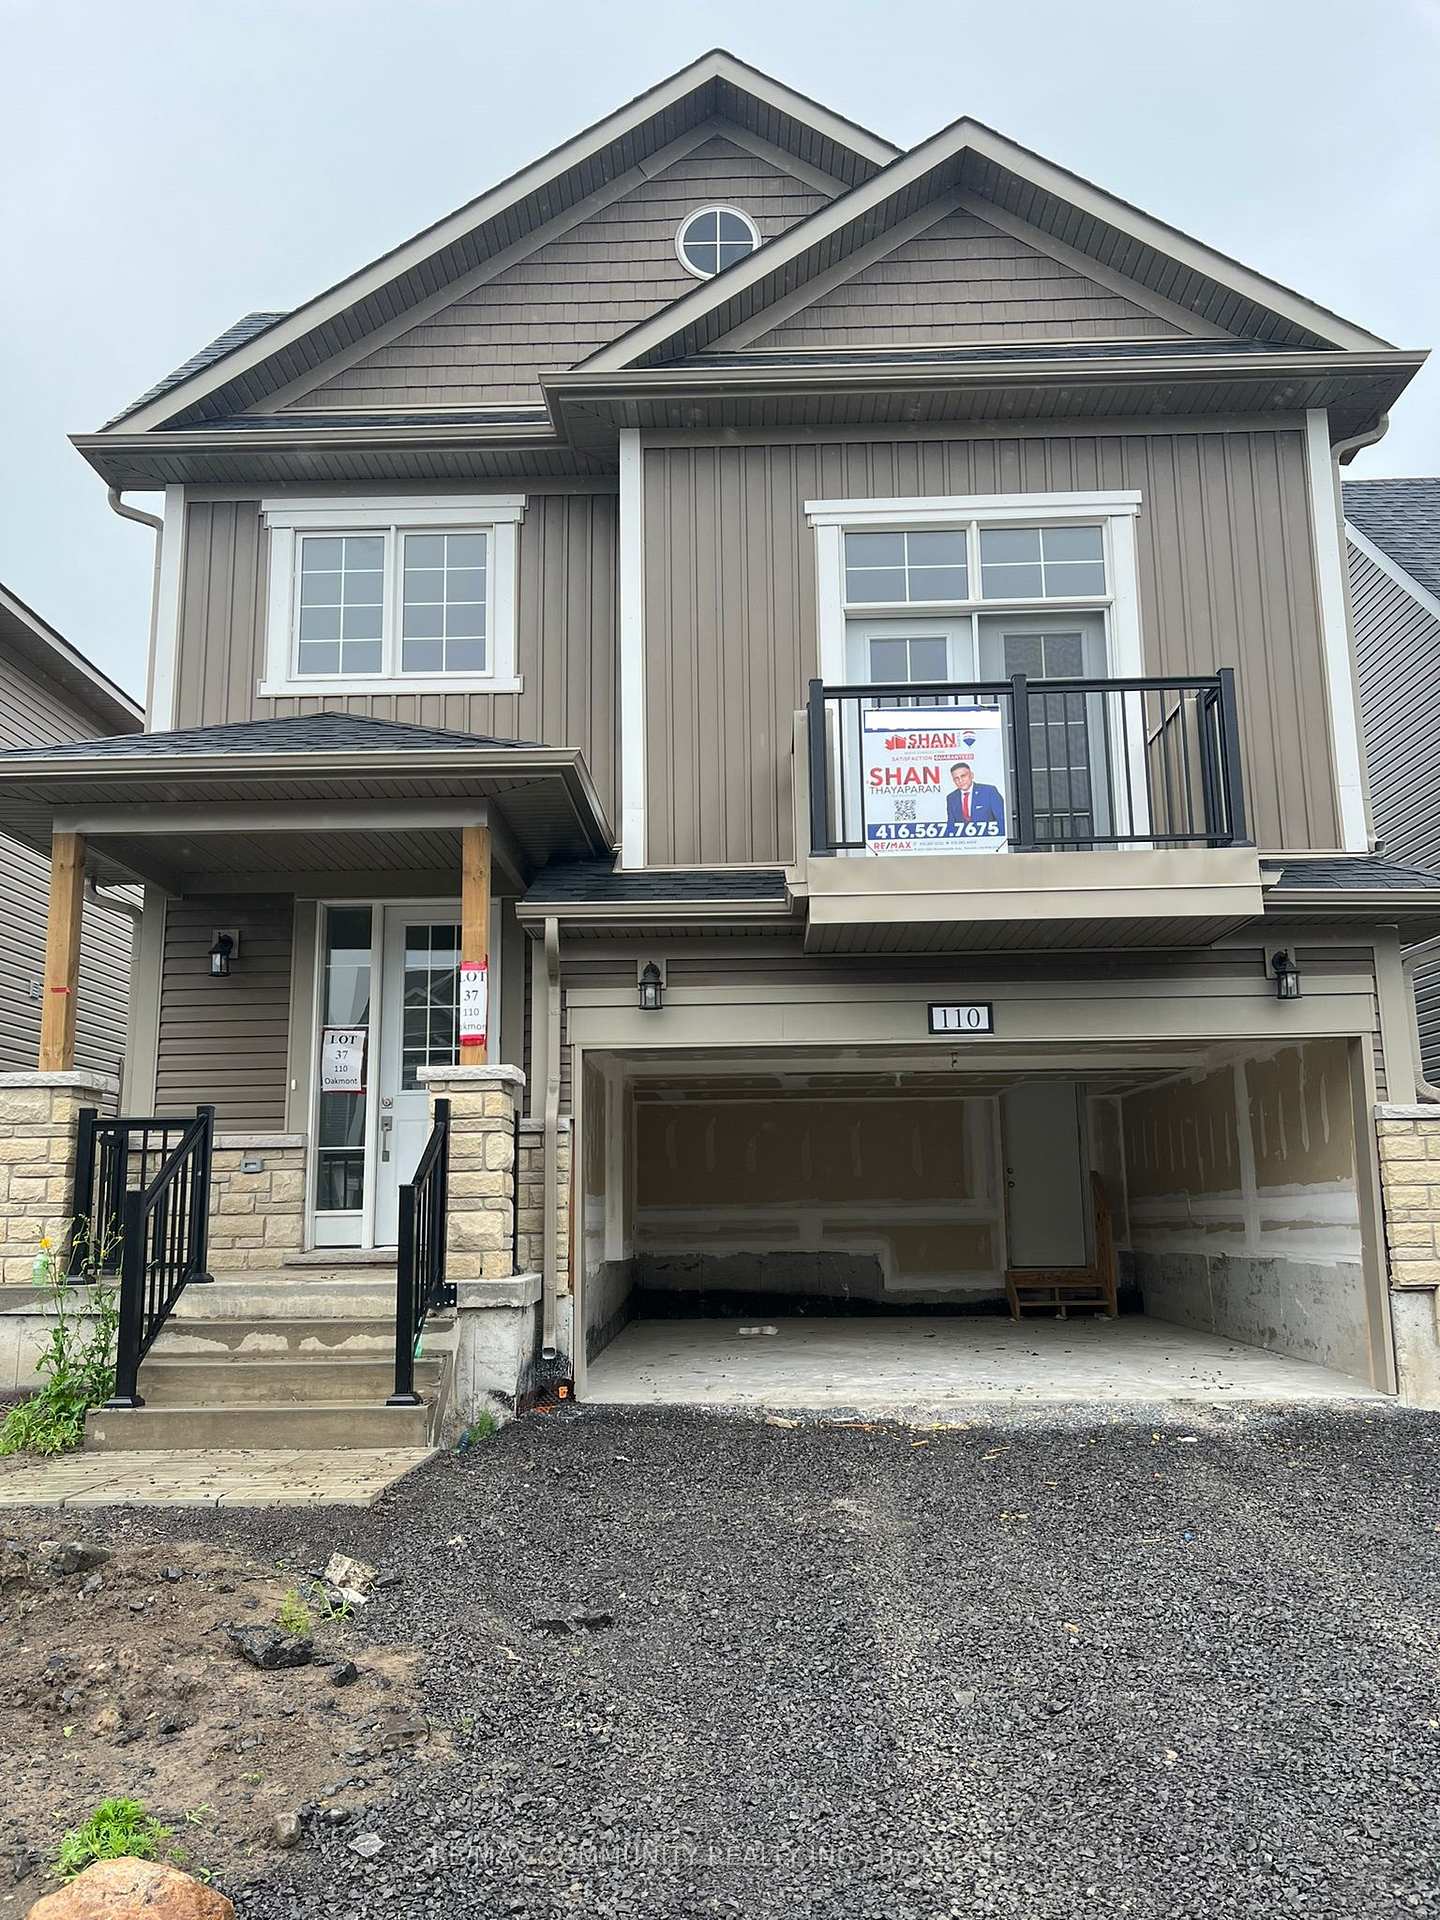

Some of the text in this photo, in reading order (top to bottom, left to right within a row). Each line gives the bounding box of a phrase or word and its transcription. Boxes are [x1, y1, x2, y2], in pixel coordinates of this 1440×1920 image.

[908, 733, 956, 746] SHAN
[870, 766, 940, 786] SHAN
[869, 785, 941, 795] THAYAPARAN
[876, 822, 999, 839] 416.567.7675
[873, 841, 912, 850] RE/MAX
[464, 990, 478, 1001] 37
[464, 1008, 479, 1016] 110
[941, 1008, 980, 1028] 110
[331, 1035, 357, 1044] LOT
[335, 1050, 348, 1060] 37
[335, 1065, 348, 1073] 110
[324, 1077, 358, 1085] Oakmont
